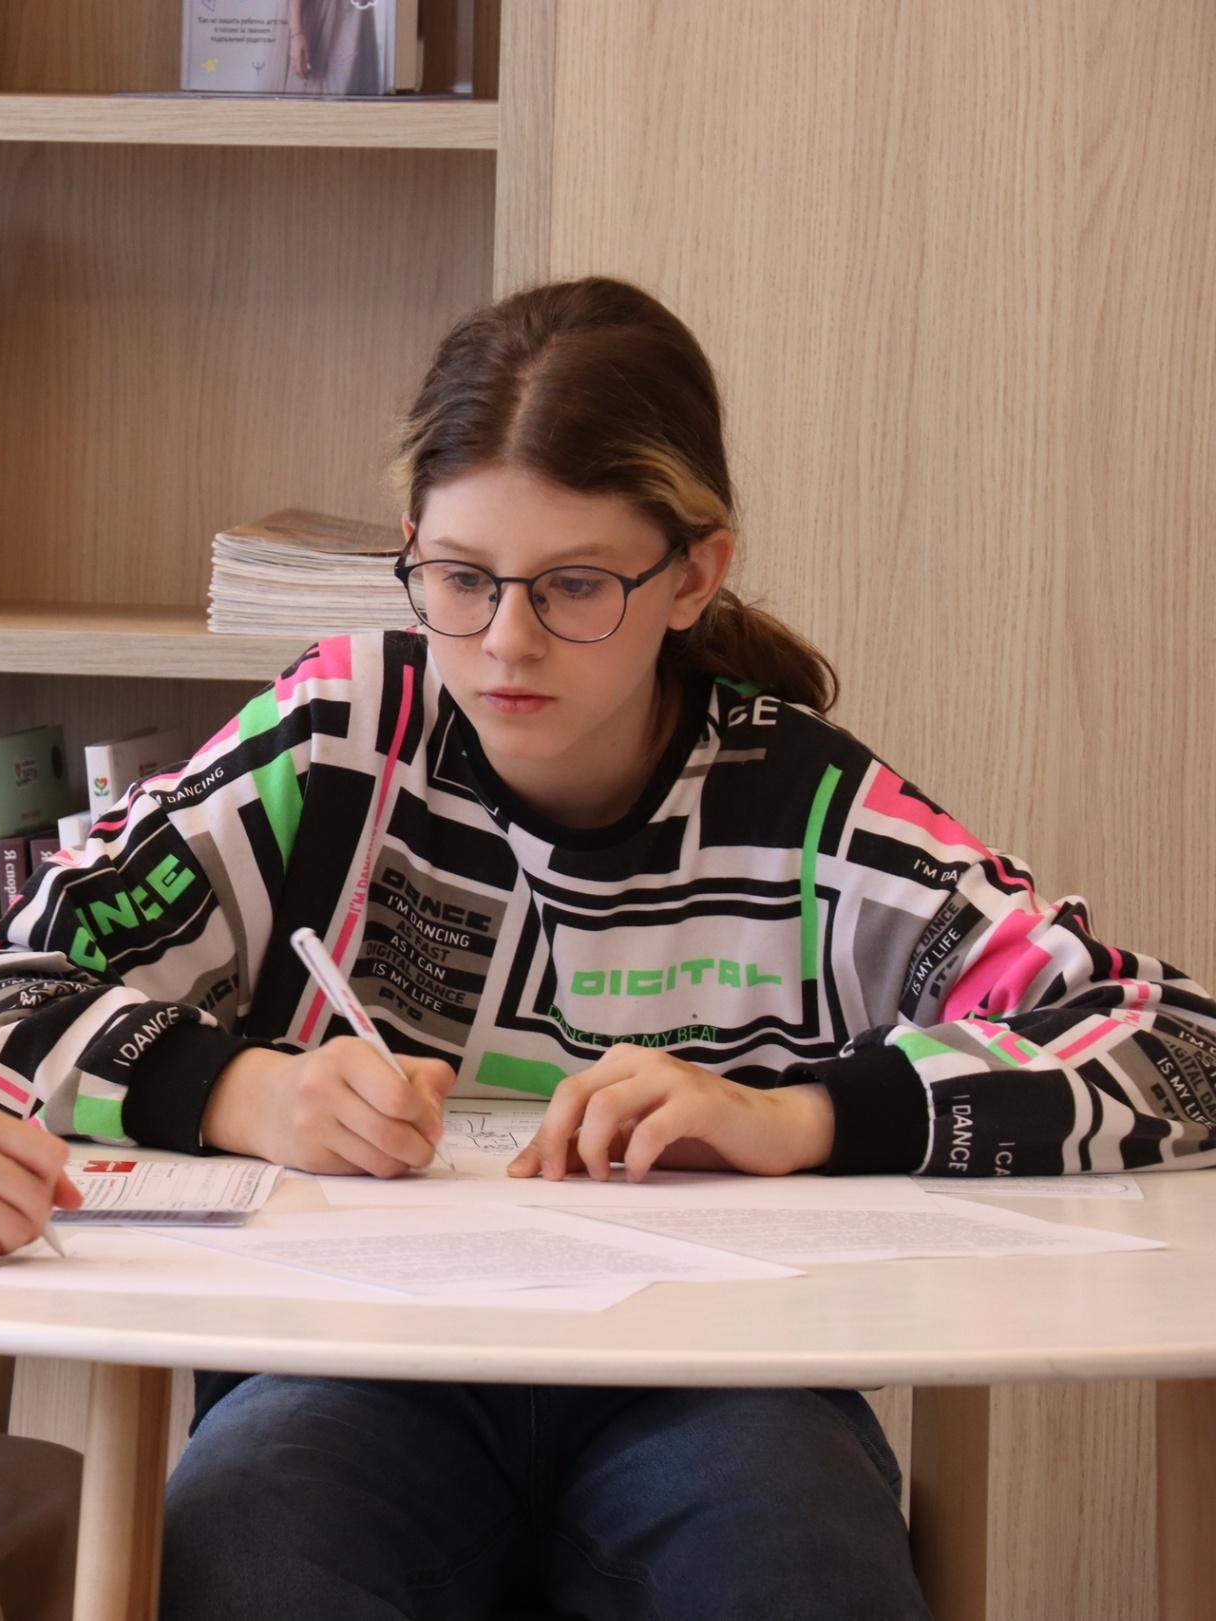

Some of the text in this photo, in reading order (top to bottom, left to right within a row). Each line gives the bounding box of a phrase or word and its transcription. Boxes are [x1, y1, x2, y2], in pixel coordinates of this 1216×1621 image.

[166, 766, 225, 804] DANCING
[3, 849, 17, 861] Я
[912, 858, 938, 880] I'M
[386, 894, 471, 948] I'M DANCING
[396, 922, 452, 964] AS FAST
[920, 902, 961, 948] DANCE
[365, 942, 468, 1005] DIGITAL DANCE
[389, 934, 407, 954] AS
[416, 956, 447, 980] CAN
[570, 958, 782, 996] DIGITAL
[910, 927, 962, 997] IS MY LIFE
[371, 961, 443, 1014] IS MY LIFE
[112, 1005, 180, 1067] I DANCE
[608, 1034, 636, 1045] TO
[641, 1029, 671, 1049] MY
[676, 1025, 721, 1045] BEAT
[1177, 1030, 1205, 1049] I'M
[1156, 1056, 1175, 1075] IS
[1169, 1074, 1192, 1100] MY
[947, 1104, 974, 1172] DANCE
